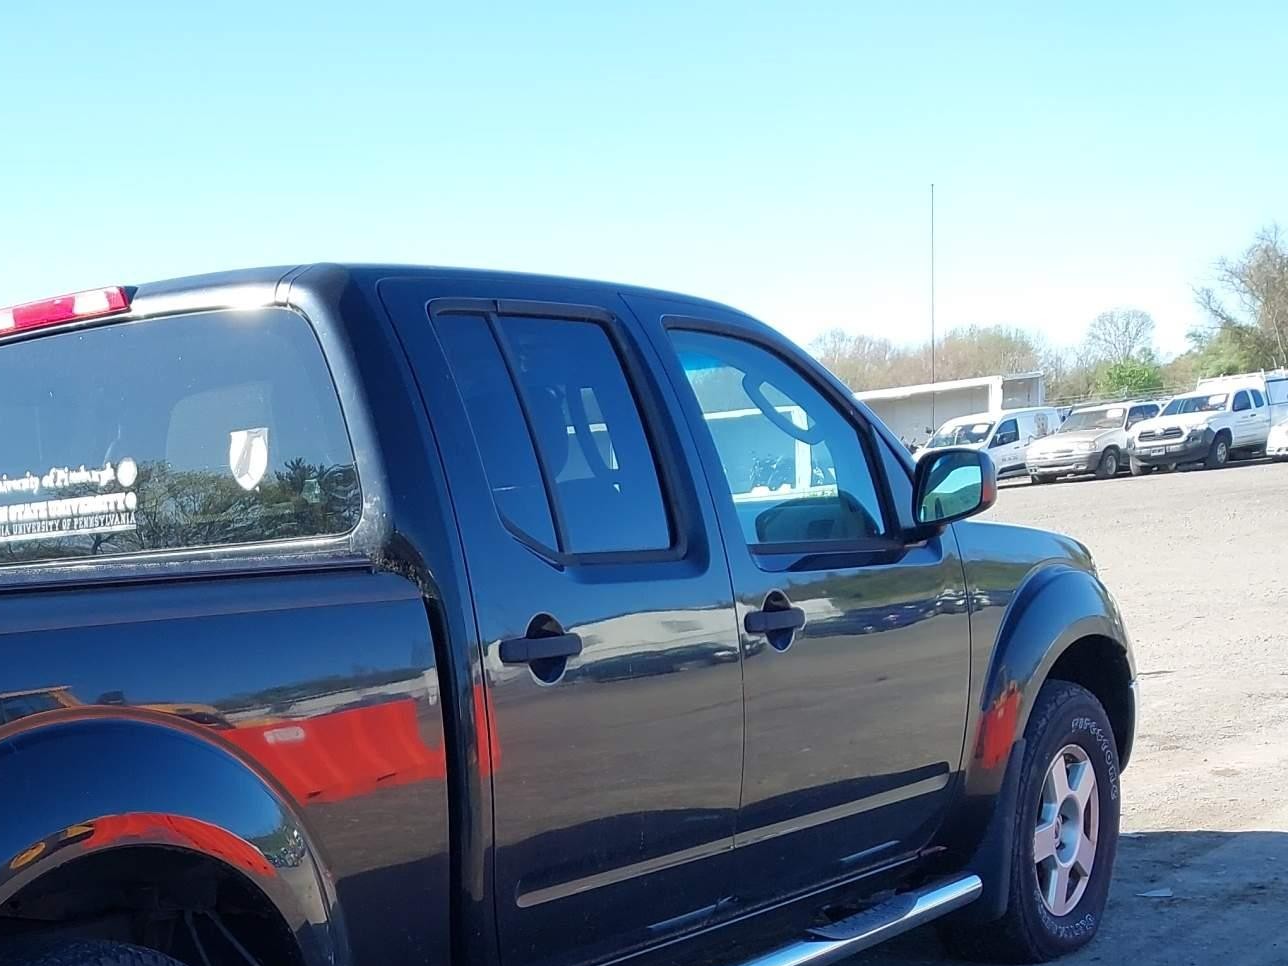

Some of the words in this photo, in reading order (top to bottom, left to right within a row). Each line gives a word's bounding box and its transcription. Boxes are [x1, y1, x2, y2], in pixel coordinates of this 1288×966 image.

[12, 519, 59, 534] UNIVERSITY
[62, 518, 71, 529] OF
[73, 512, 136, 529] PENNSYLVANIA
